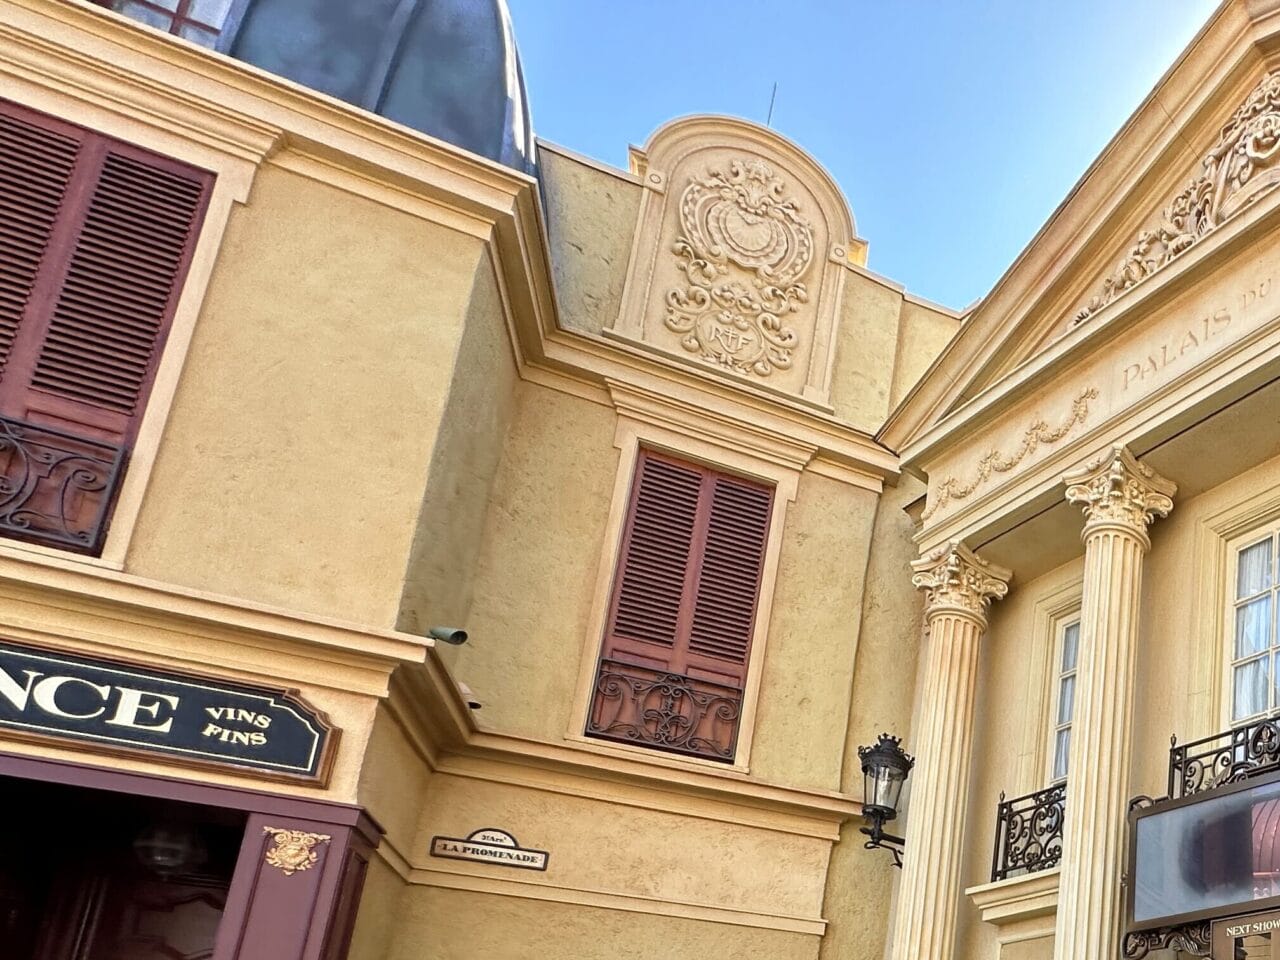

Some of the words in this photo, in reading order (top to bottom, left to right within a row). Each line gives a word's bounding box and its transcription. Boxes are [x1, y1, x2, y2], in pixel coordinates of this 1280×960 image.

[1122, 307, 1232, 391] PALAIS
[205, 707, 272, 729] VINS
[202, 722, 267, 746] FINS
[462, 846, 538, 864] PROMENADE
[1226, 924, 1251, 937] NEXT
